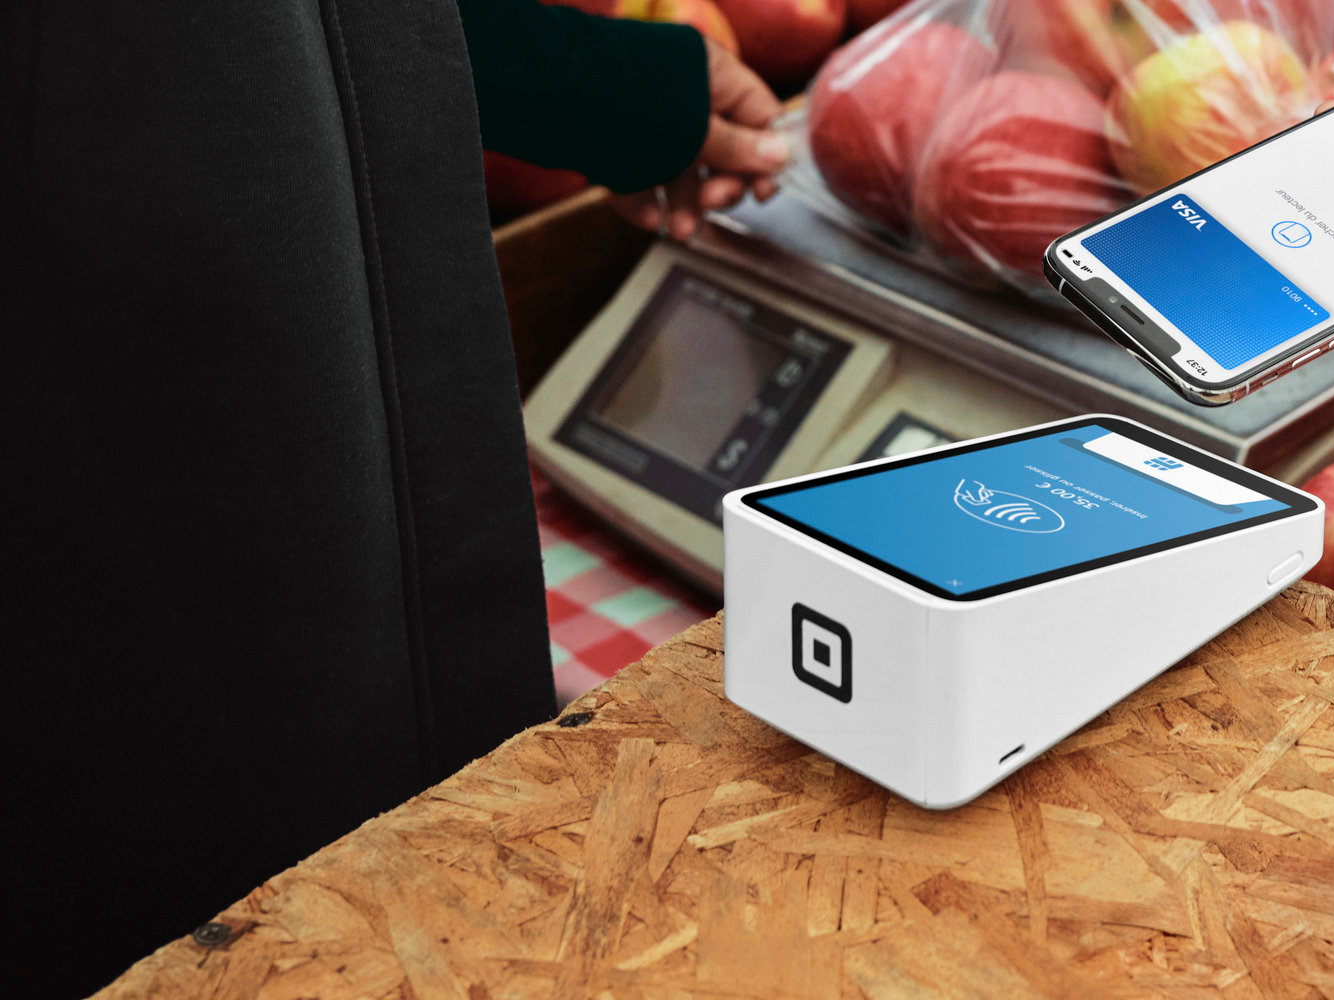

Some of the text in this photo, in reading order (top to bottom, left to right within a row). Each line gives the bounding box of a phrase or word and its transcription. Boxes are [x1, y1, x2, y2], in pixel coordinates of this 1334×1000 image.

[1275, 189, 1307, 217] lecteur
[1171, 200, 1207, 231] VISA
[1304, 210, 1318, 222] du
[1281, 286, 1303, 303] 9010
[1186, 358, 1209, 376] 12:37
[1023, 464, 1061, 480] glisser
[1058, 479, 1074, 487] ou
[1034, 481, 1100, 510] 35,00 €
[1073, 486, 1111, 502] passer
